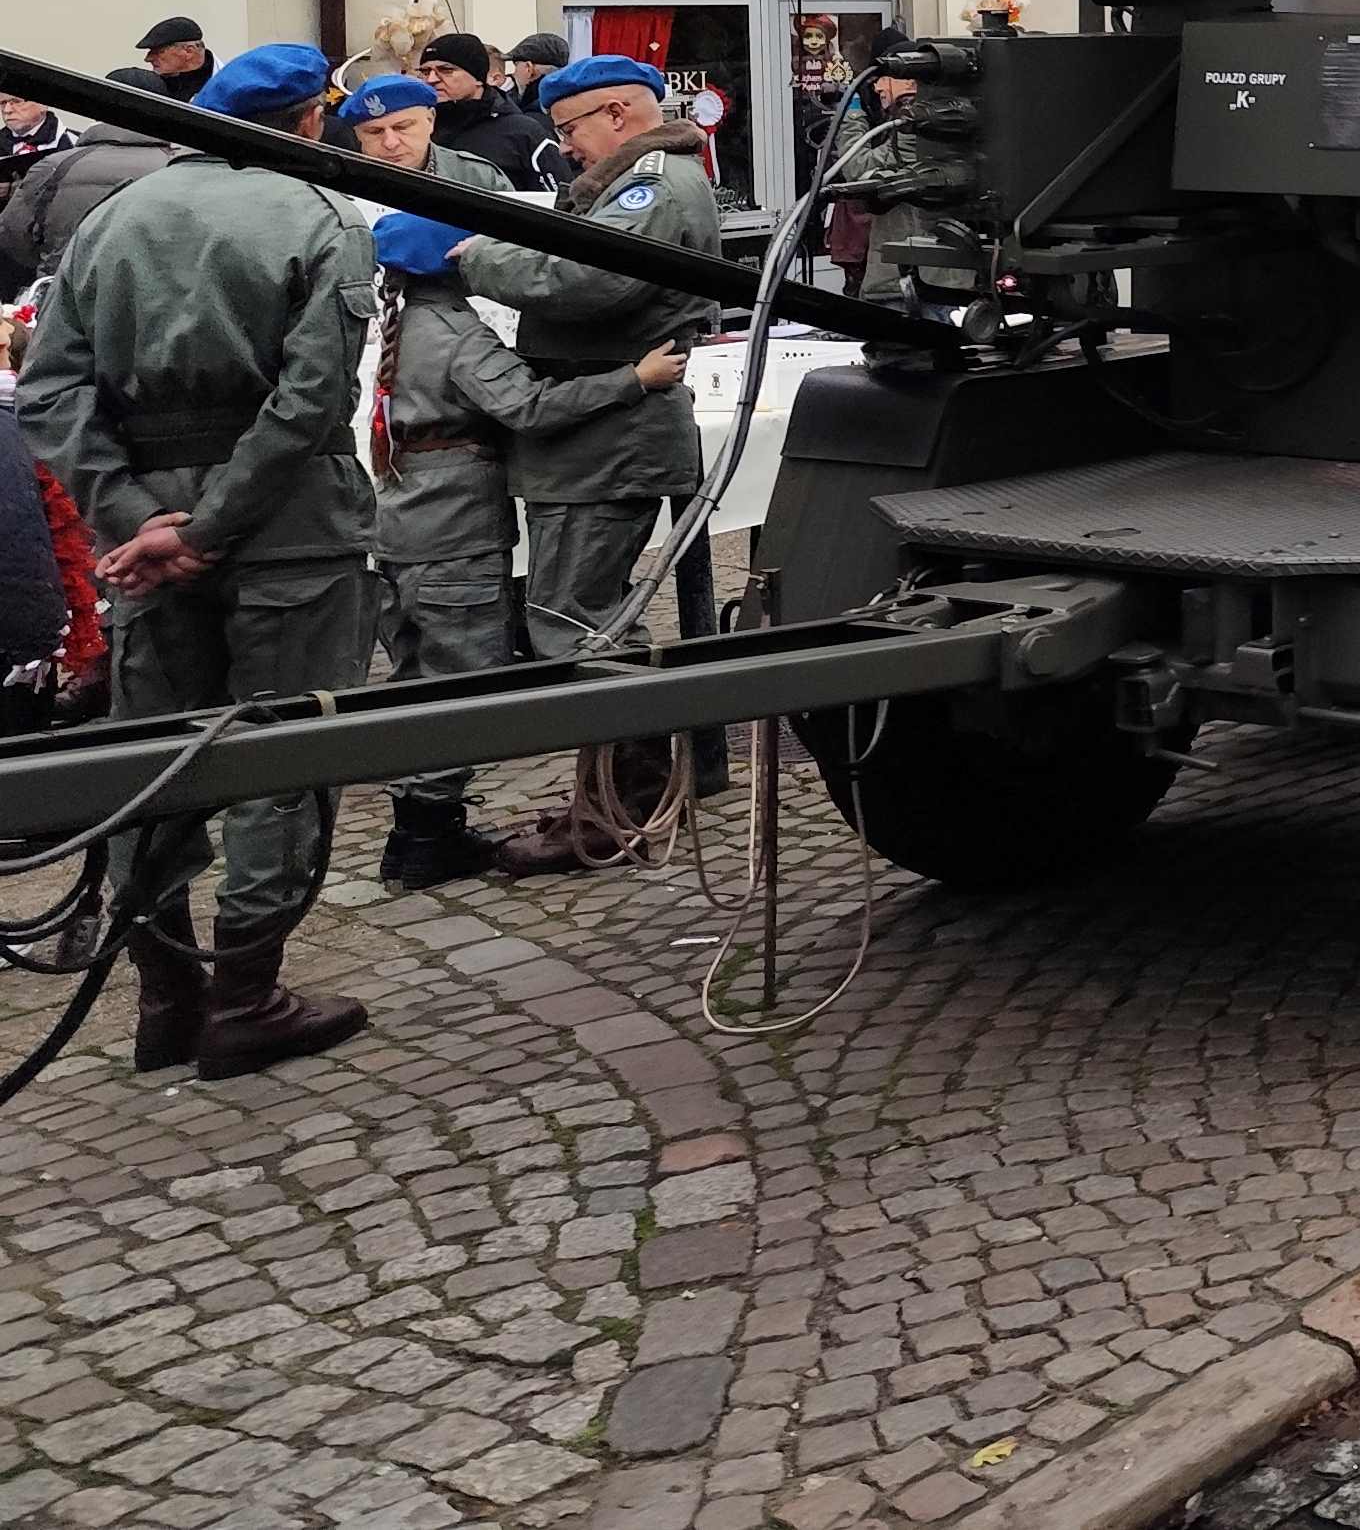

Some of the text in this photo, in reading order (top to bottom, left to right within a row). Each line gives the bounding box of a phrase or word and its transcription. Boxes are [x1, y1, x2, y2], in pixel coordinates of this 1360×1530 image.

[663, 70, 708, 91] BKI
[1205, 72, 1287, 86] POJAZD GRUPY
